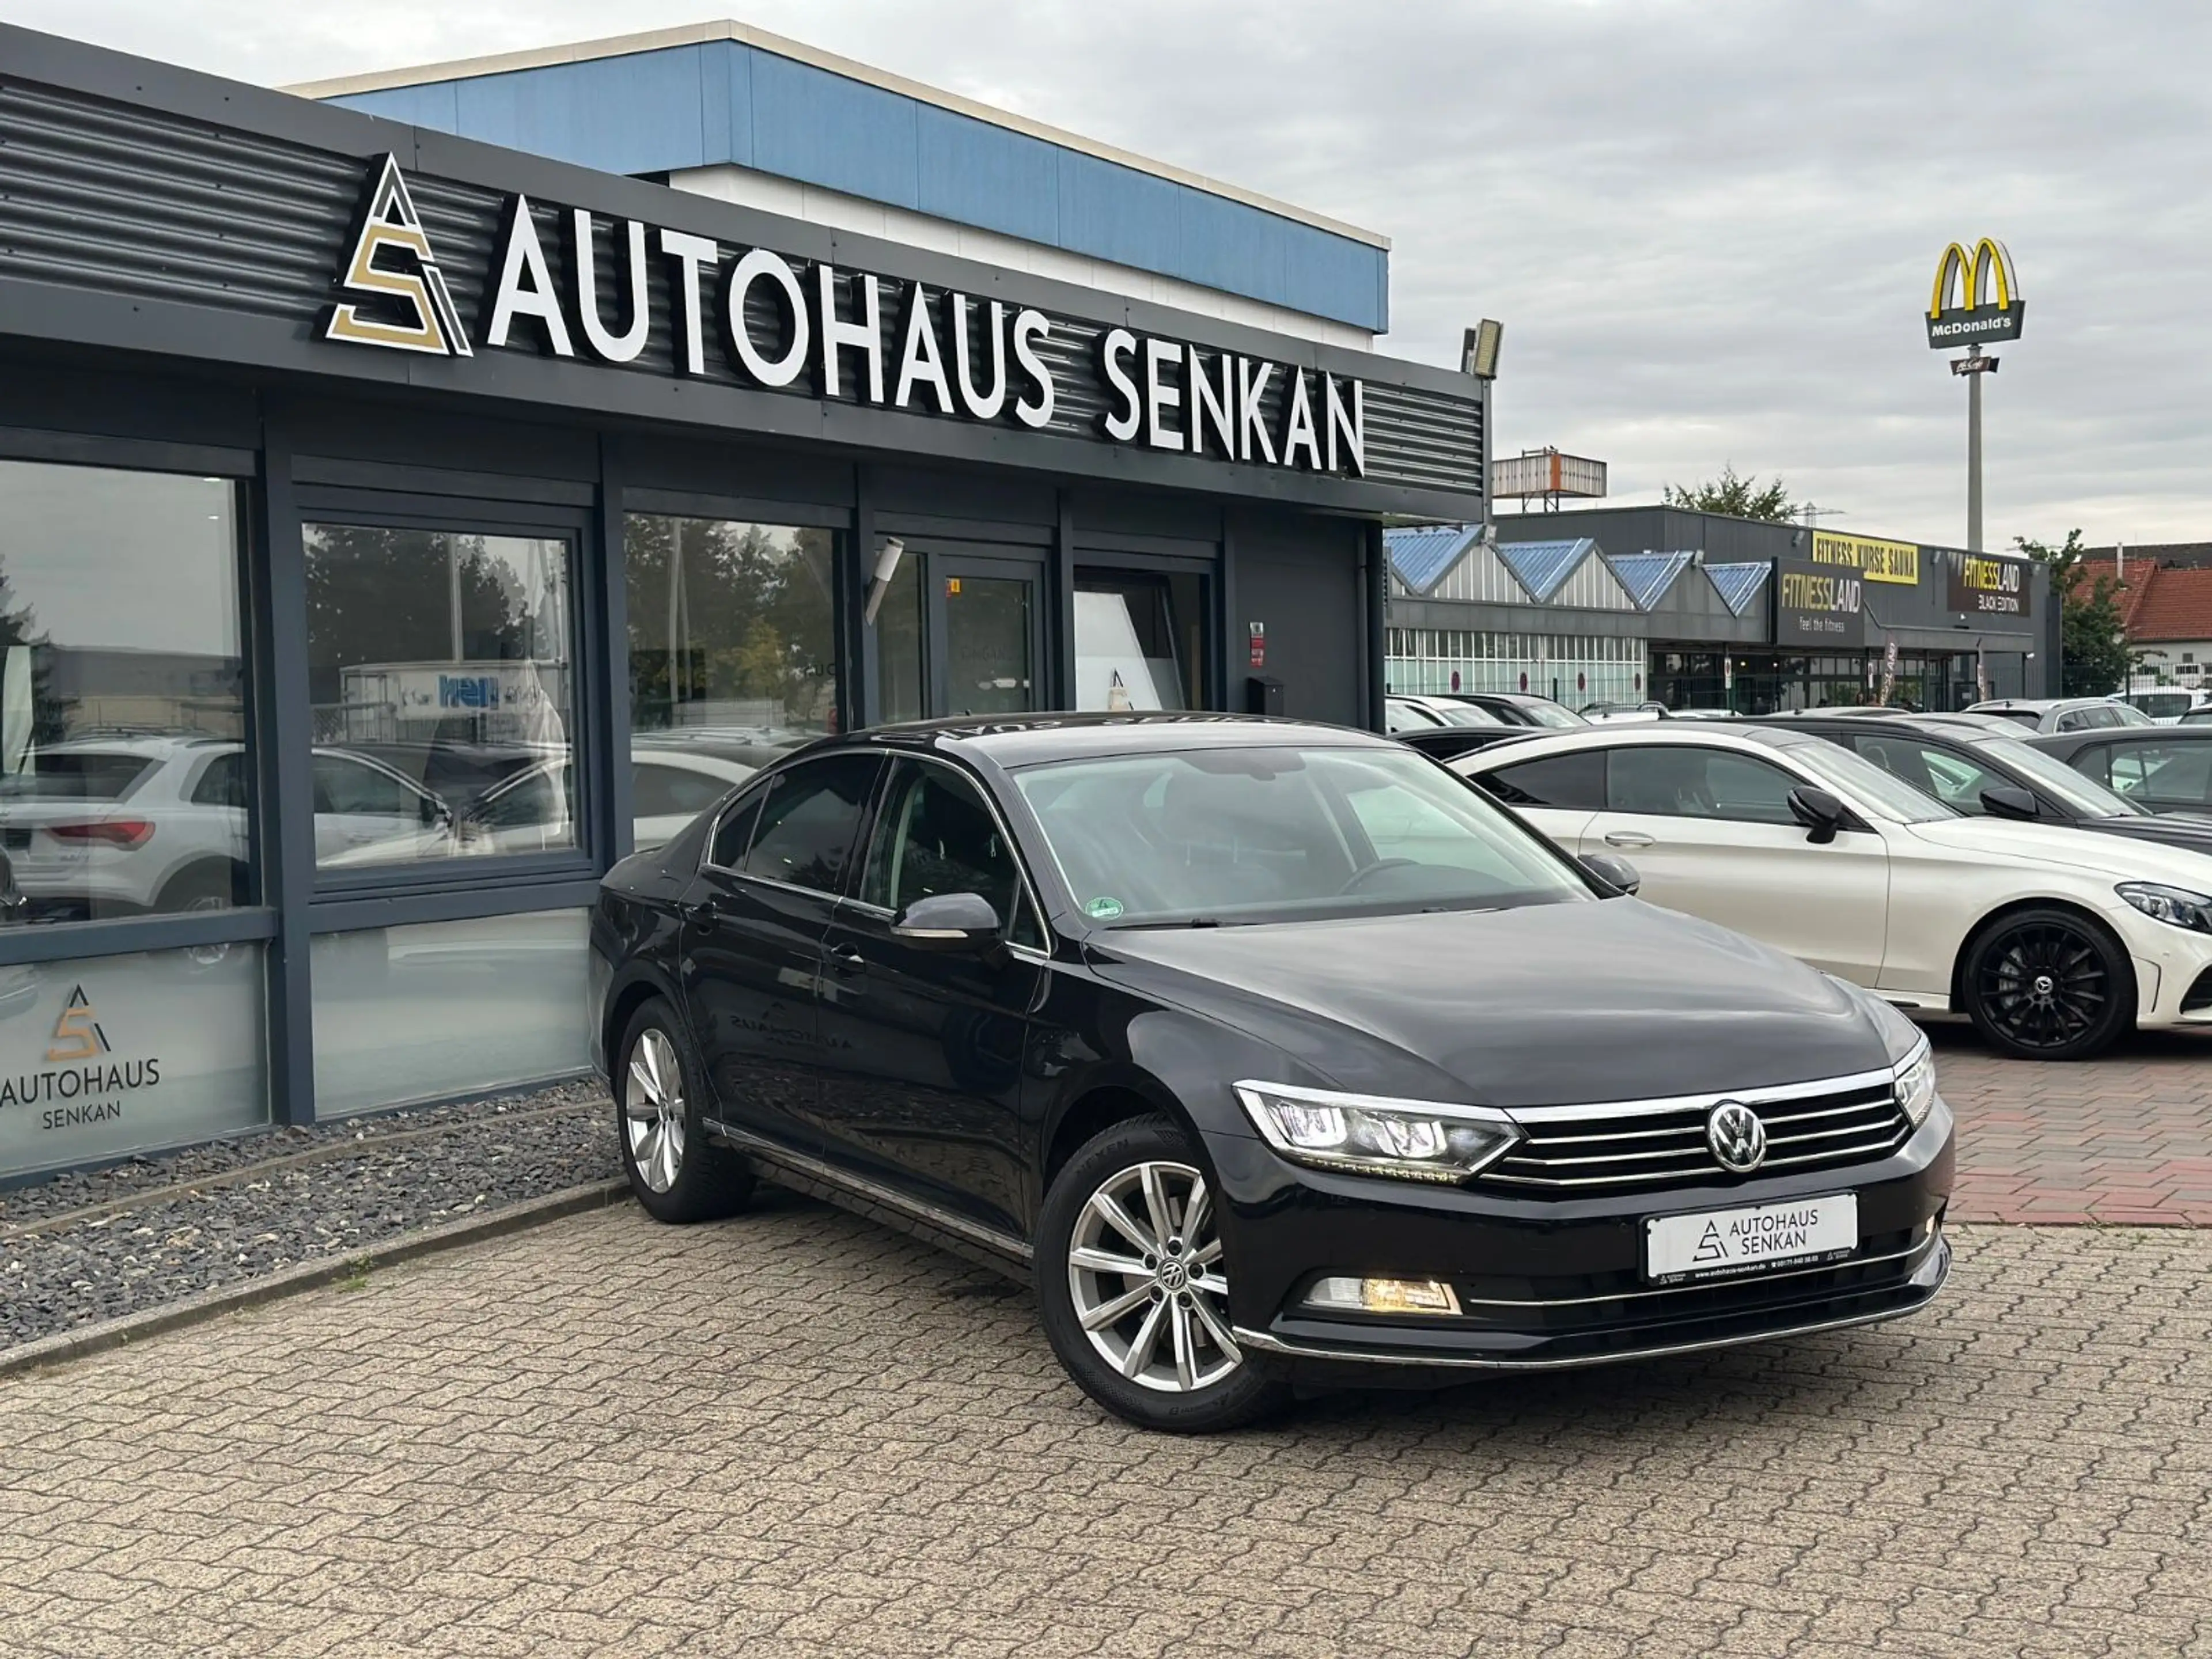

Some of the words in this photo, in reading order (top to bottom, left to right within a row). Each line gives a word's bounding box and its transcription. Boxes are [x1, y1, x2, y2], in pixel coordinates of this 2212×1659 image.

[487, 194, 1054, 428] AUTOHAUS
[1103, 328, 1365, 477] SENKAN
[1931, 317, 2012, 337] McDonald's
[1816, 537, 1853, 567] FITNESS
[1888, 548, 1915, 578] SAUNA
[1964, 557, 2020, 593] FITNESSLAND
[1782, 573, 1860, 613] FITNESSLAND
[1997, 596, 2020, 612] EDITION
[0, 1058, 160, 1108] AUTOHAUS
[43, 1100, 120, 1129] SENKAN
[1729, 1209, 1819, 1237] AUTOHAUS
[1741, 1230, 1807, 1256] SENKAN
